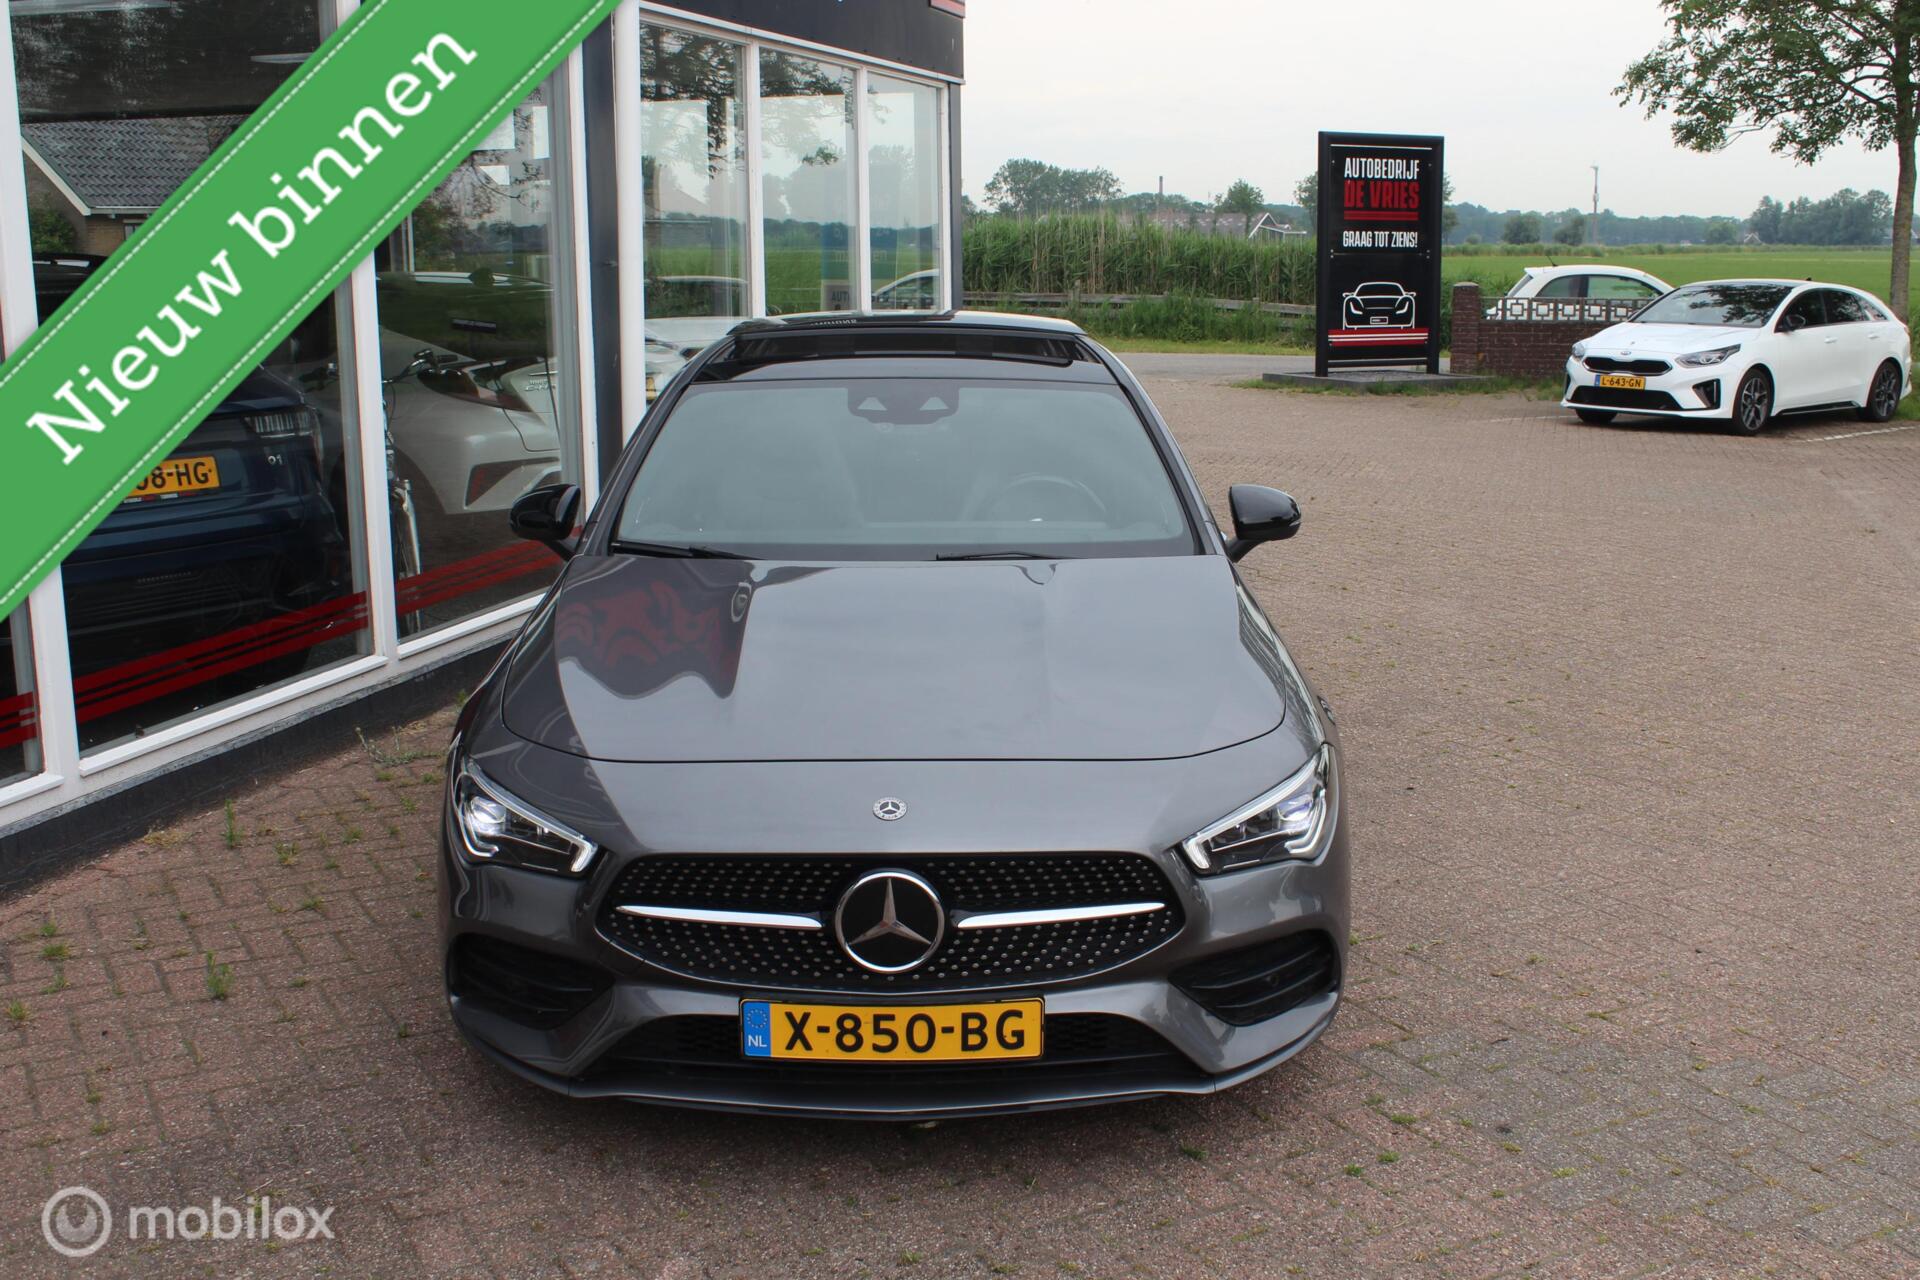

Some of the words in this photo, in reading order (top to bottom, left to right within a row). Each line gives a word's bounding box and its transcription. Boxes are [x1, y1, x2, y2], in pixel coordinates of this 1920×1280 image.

[1344, 158, 1420, 180] AUTOBEDRIJF
[1344, 180, 1364, 208] DE
[1371, 181, 1420, 209] VRIES
[1343, 231, 1372, 247] GRAAG
[1374, 231, 1390, 248] TOT
[1391, 232, 1418, 248] ZIENS!
[1602, 376, 1641, 388] L-643-GN
[748, 1035, 768, 1047] NL
[785, 1009, 1025, 1053] X-850-BG
